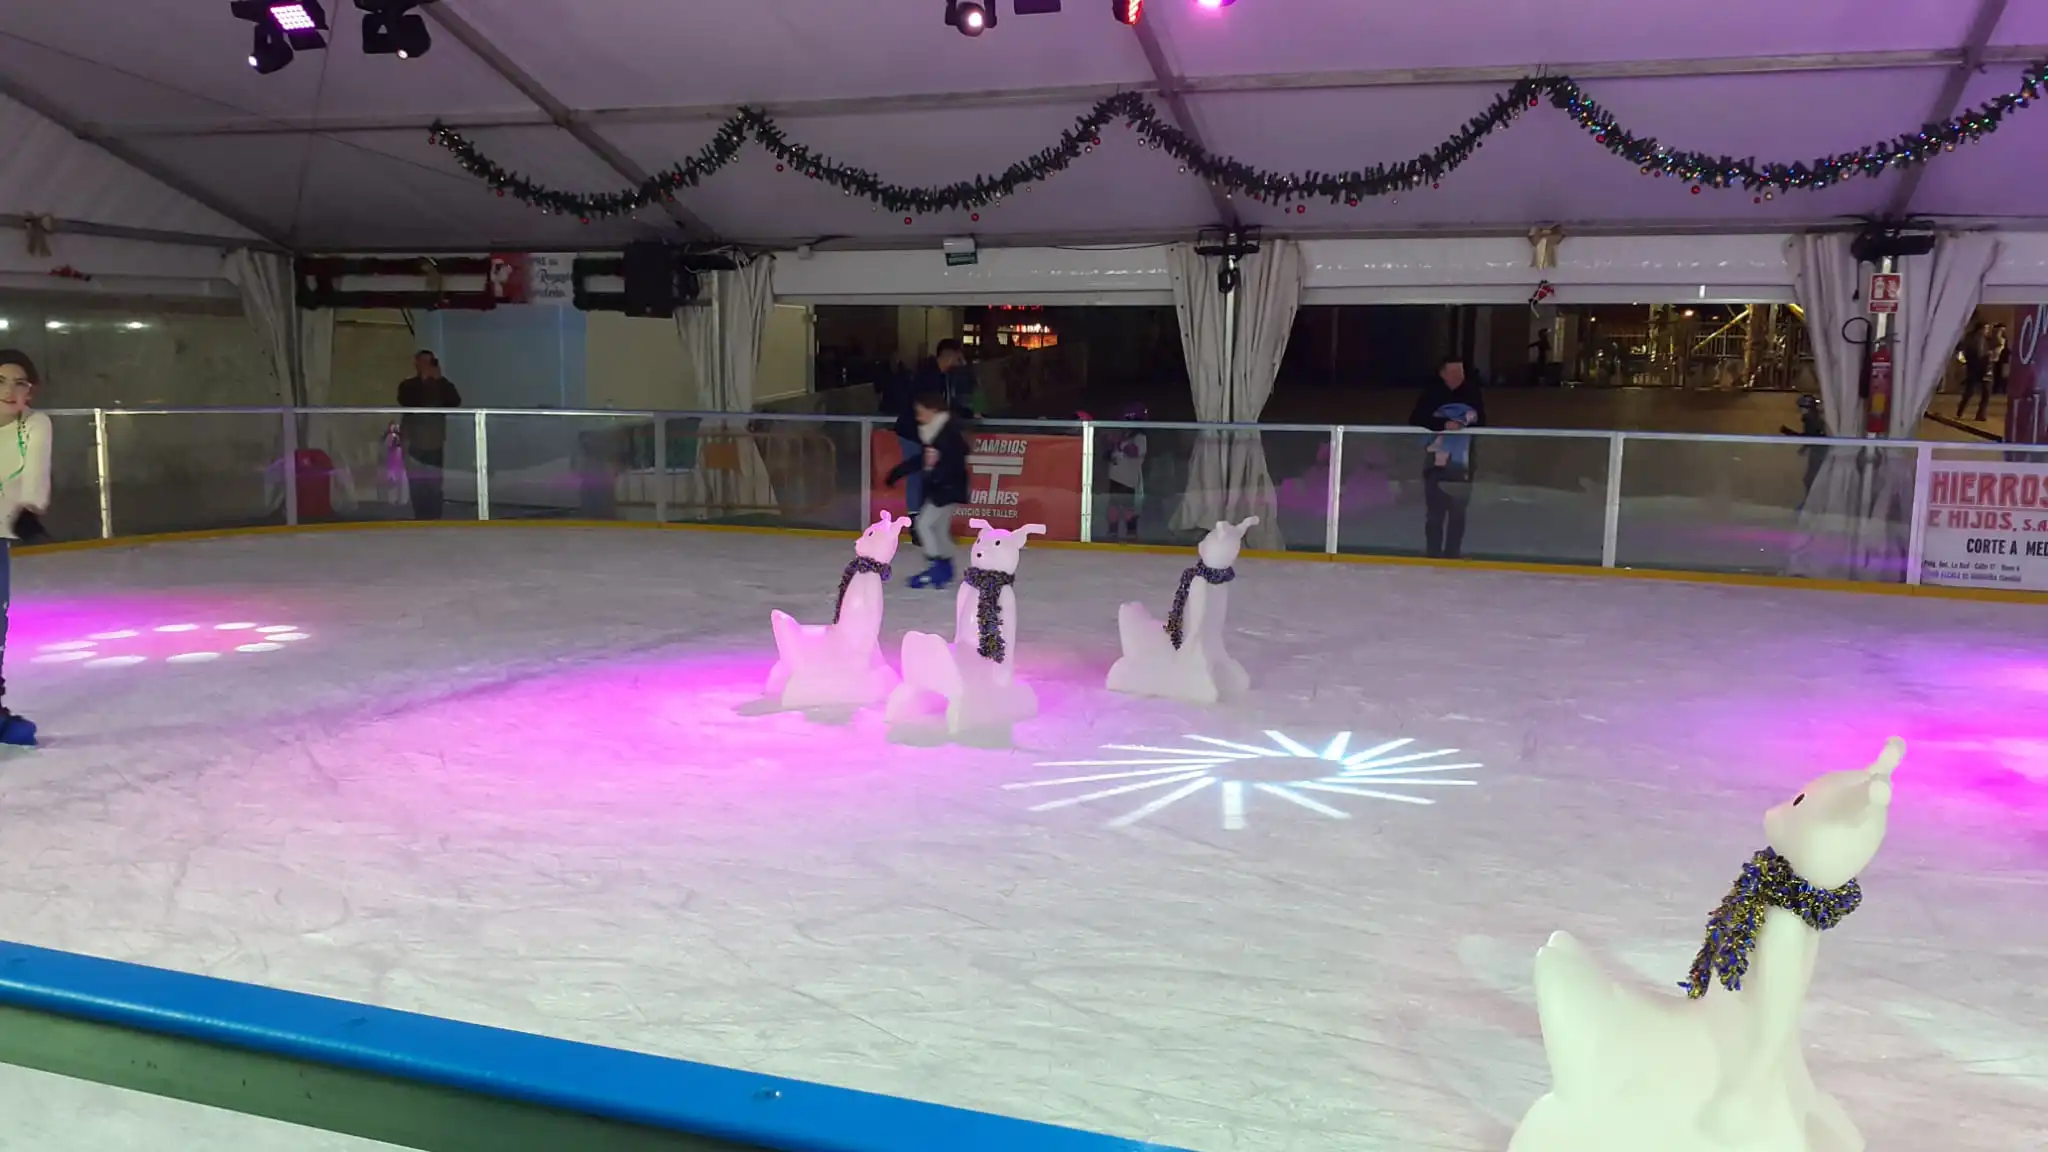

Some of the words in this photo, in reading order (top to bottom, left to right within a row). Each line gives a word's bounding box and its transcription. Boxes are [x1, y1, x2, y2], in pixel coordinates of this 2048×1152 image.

[1928, 510, 1942, 527] E
[1966, 538, 2006, 554] CORTE
[2009, 540, 2018, 555] A
